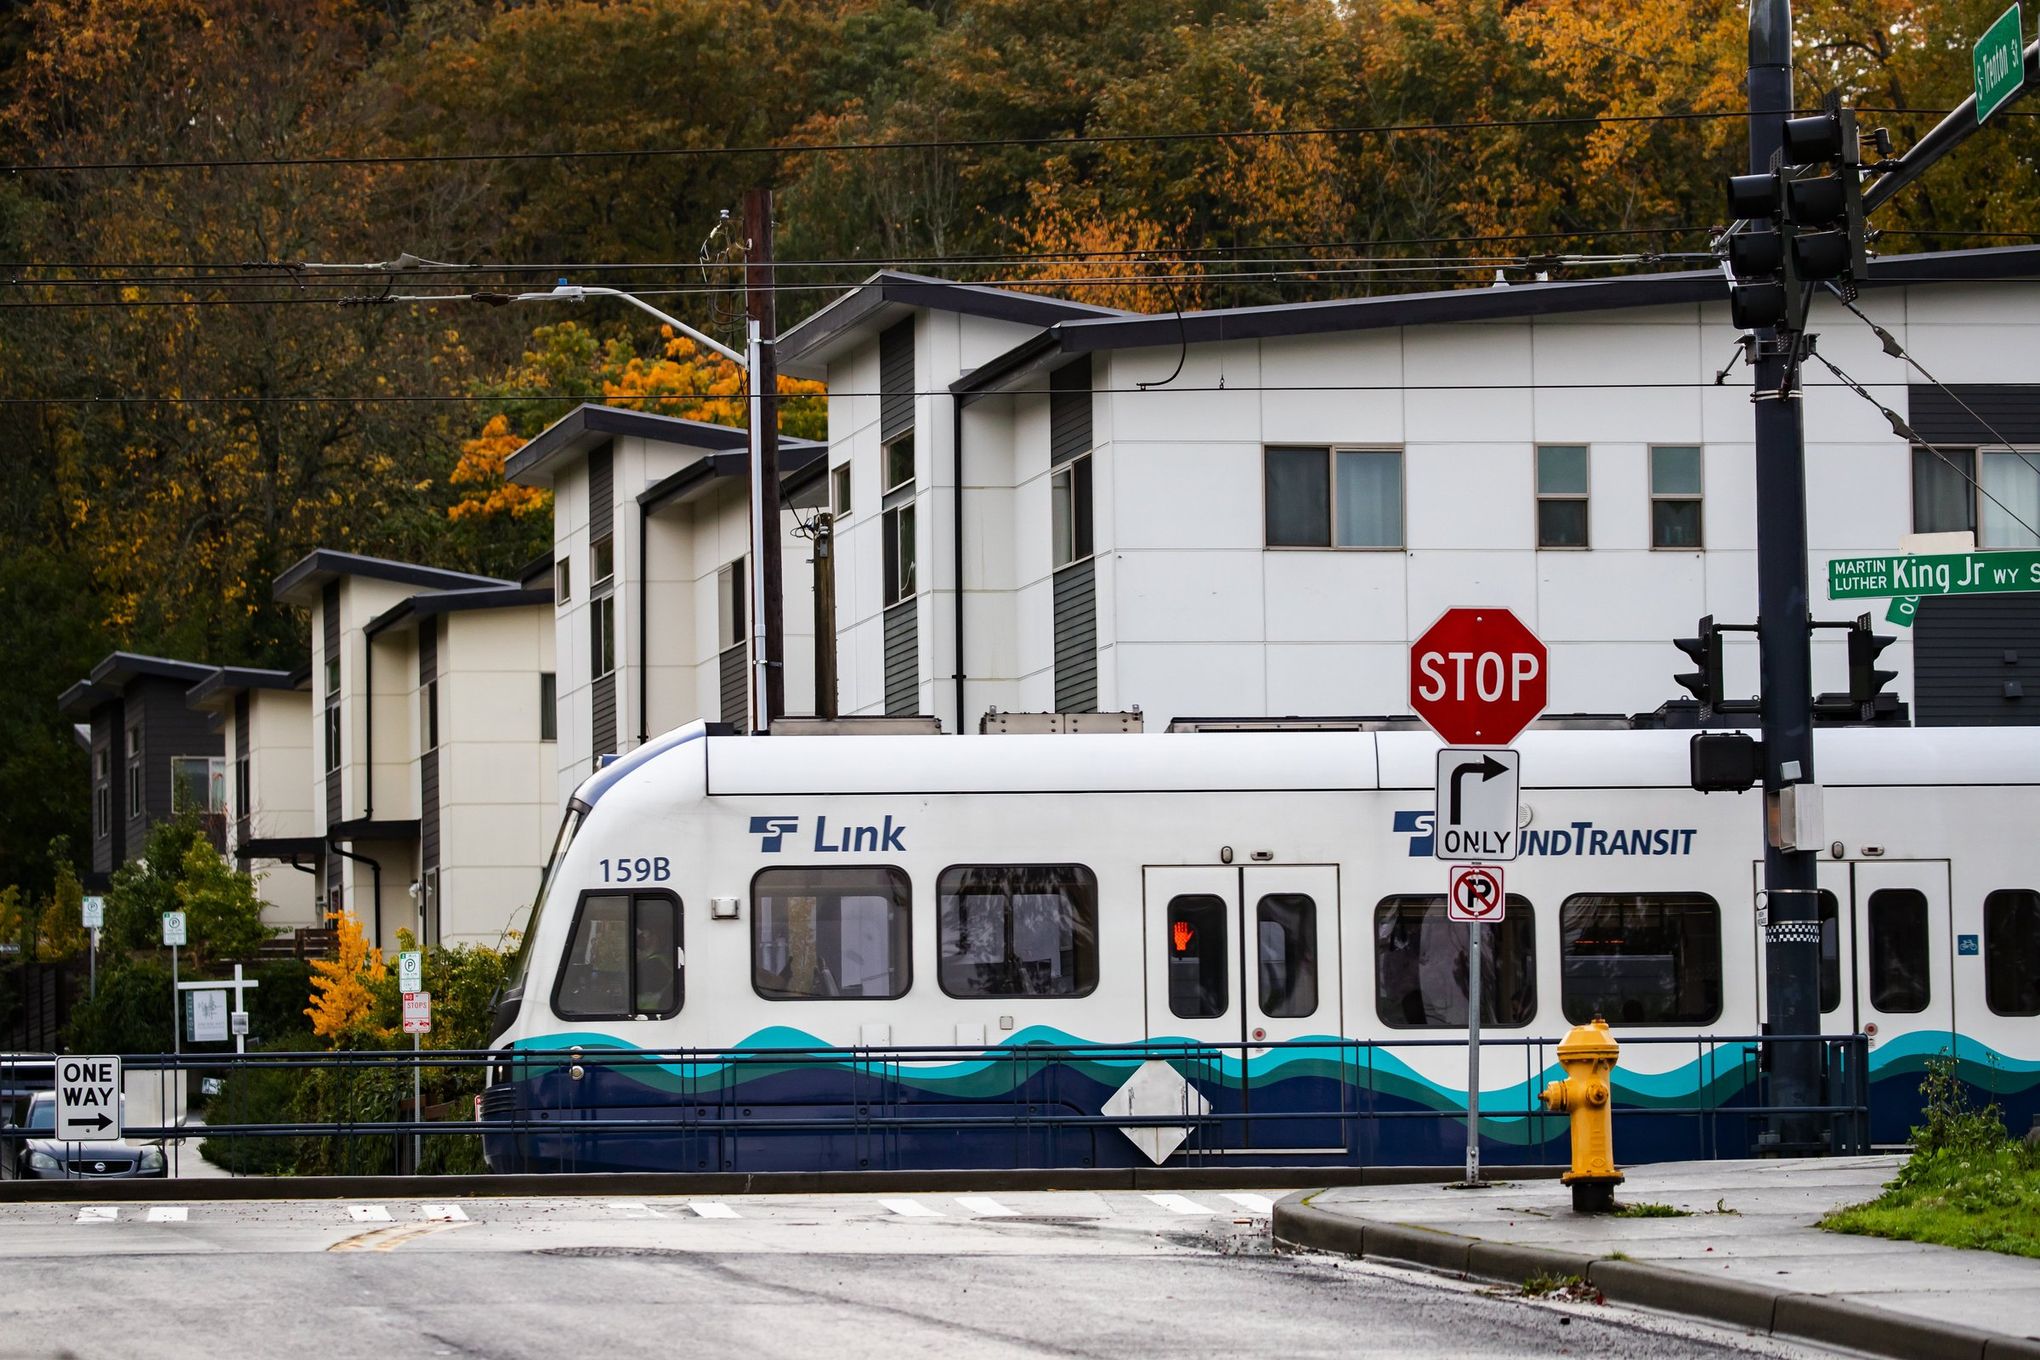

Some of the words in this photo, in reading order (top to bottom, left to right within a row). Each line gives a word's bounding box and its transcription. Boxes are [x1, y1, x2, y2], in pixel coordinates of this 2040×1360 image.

[1983, 44, 2009, 94] Trenton
[2011, 38, 2019, 68] St
[1835, 559, 1886, 575] MARTIN
[1892, 559, 1949, 594] King
[1957, 556, 1985, 586] Jr
[1993, 568, 2019, 585] WY
[1835, 576, 1887, 591] LUTHER
[1418, 651, 1540, 702] STOP
[814, 815, 907, 852] Link
[1444, 830, 1511, 854] ONLY
[599, 856, 671, 883] 159B
[63, 1063, 112, 1082] ONE
[63, 1087, 114, 1106] WAY
